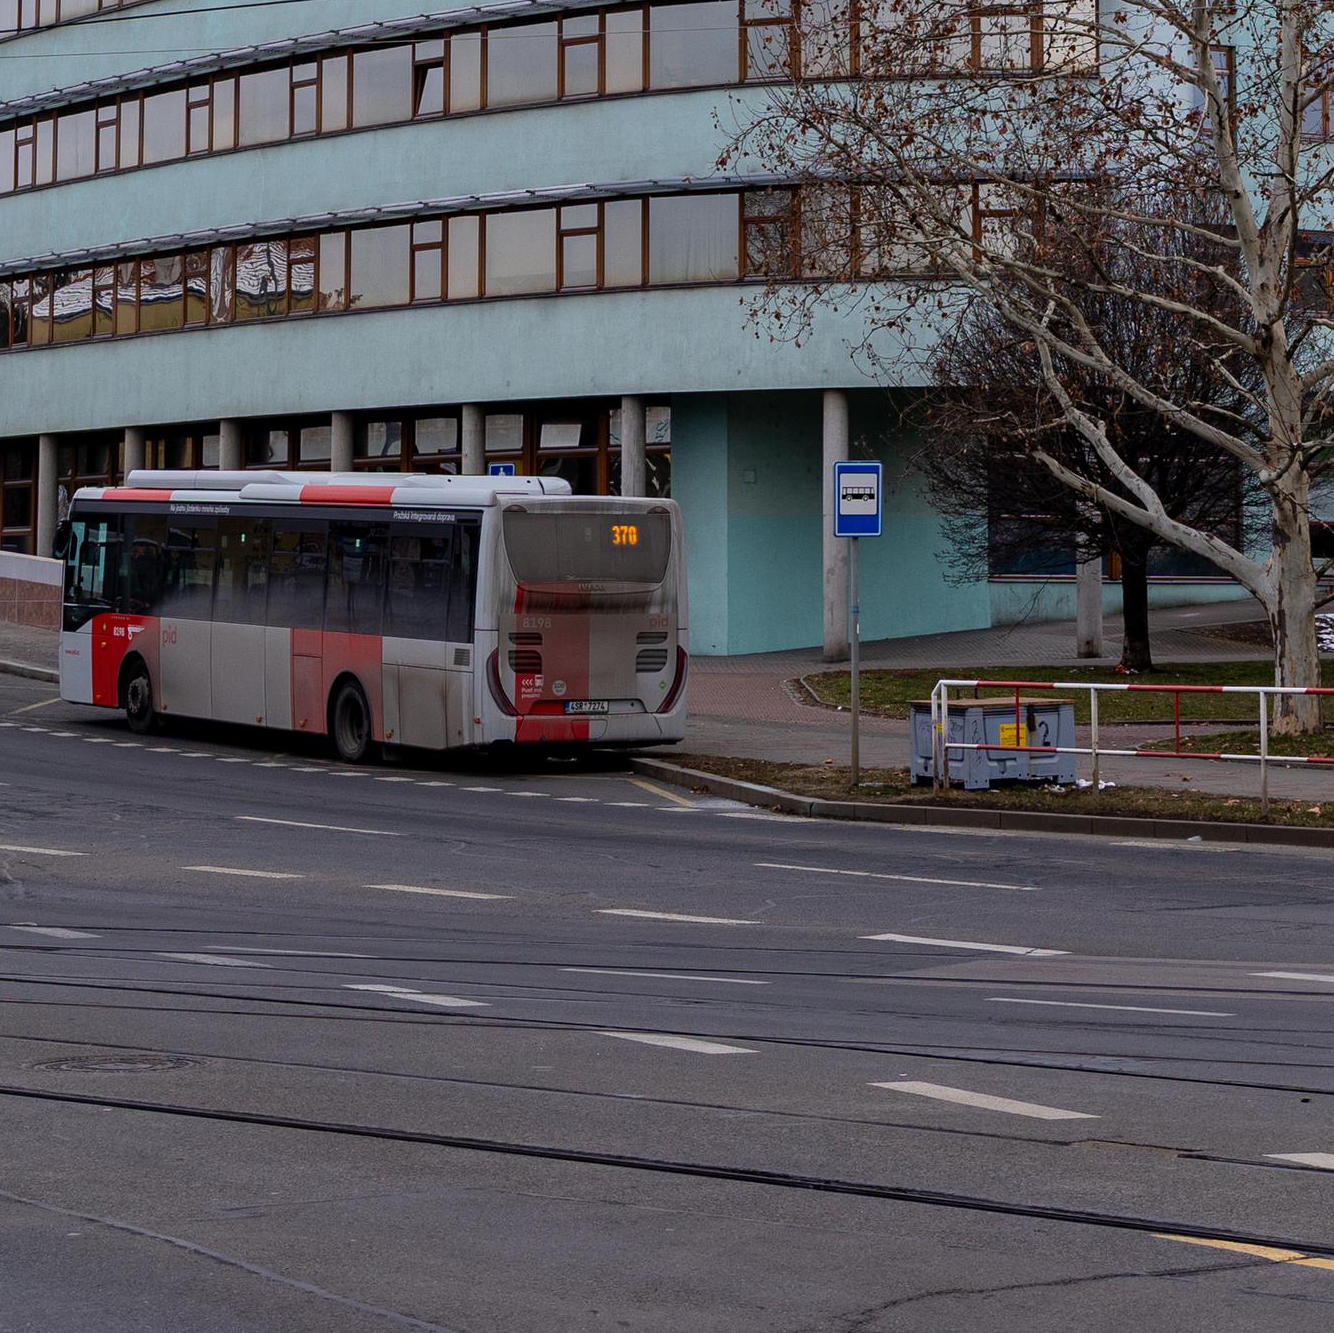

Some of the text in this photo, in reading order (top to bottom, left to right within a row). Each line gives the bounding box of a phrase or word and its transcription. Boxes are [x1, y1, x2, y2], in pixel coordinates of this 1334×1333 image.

[611, 525, 638, 545] 370
[523, 618, 552, 628] 8198
[162, 626, 177, 648] pid
[571, 702, 605, 711] 4SR 7274
